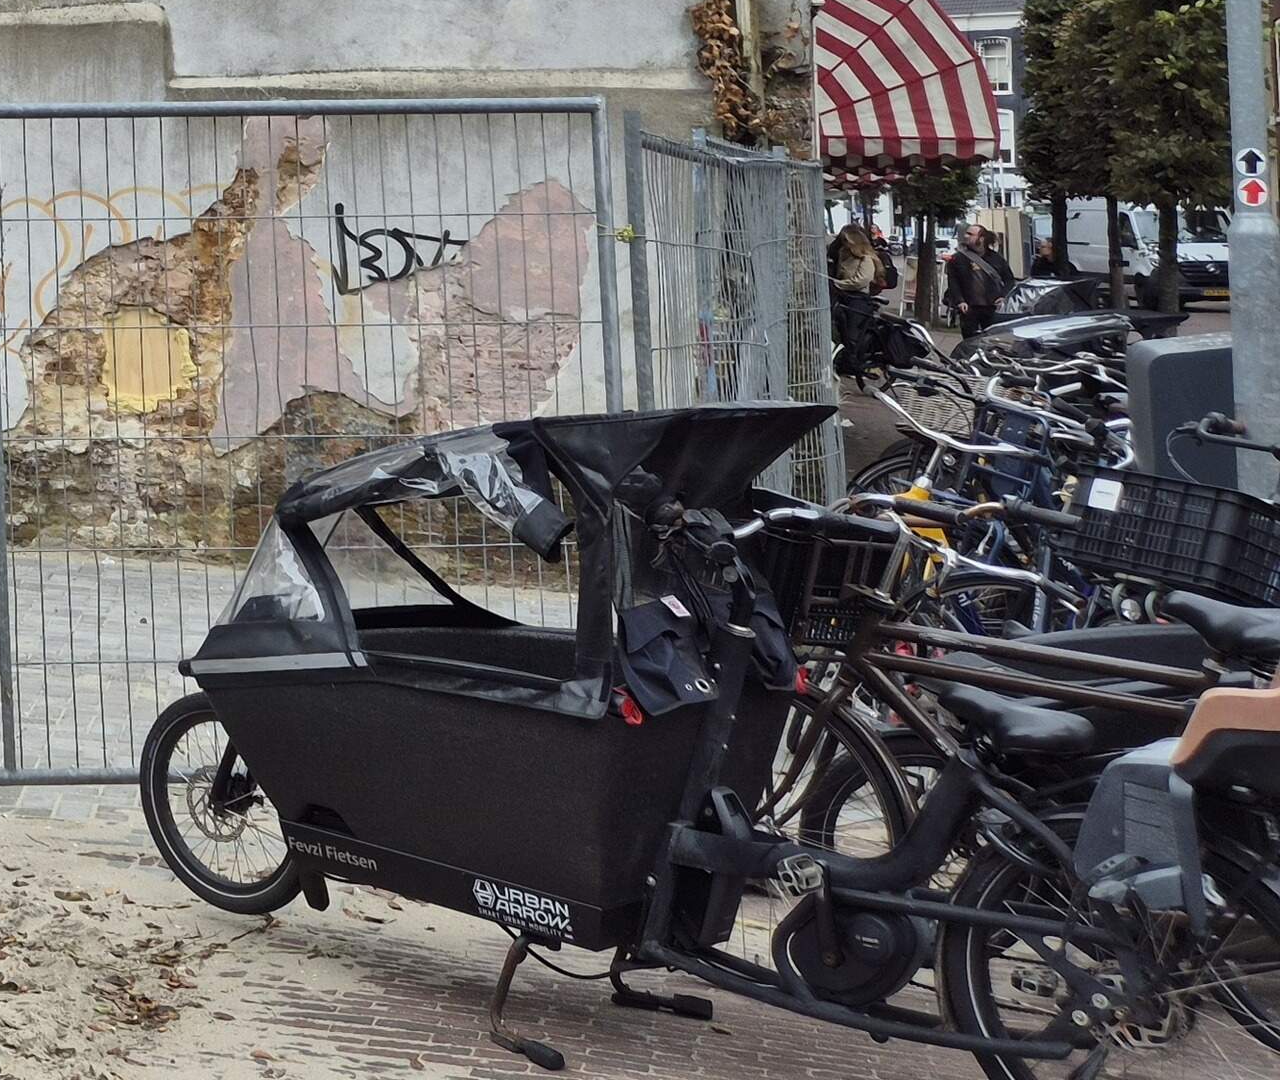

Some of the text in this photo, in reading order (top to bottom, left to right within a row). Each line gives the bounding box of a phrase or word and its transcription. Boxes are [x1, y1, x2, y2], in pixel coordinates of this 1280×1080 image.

[287, 836, 378, 871] Fevzi Fietsen
[491, 882, 570, 918] URBAN
[495, 899, 570, 931] ARROW
[478, 906, 562, 937] SMART URBAN MOBILITY
